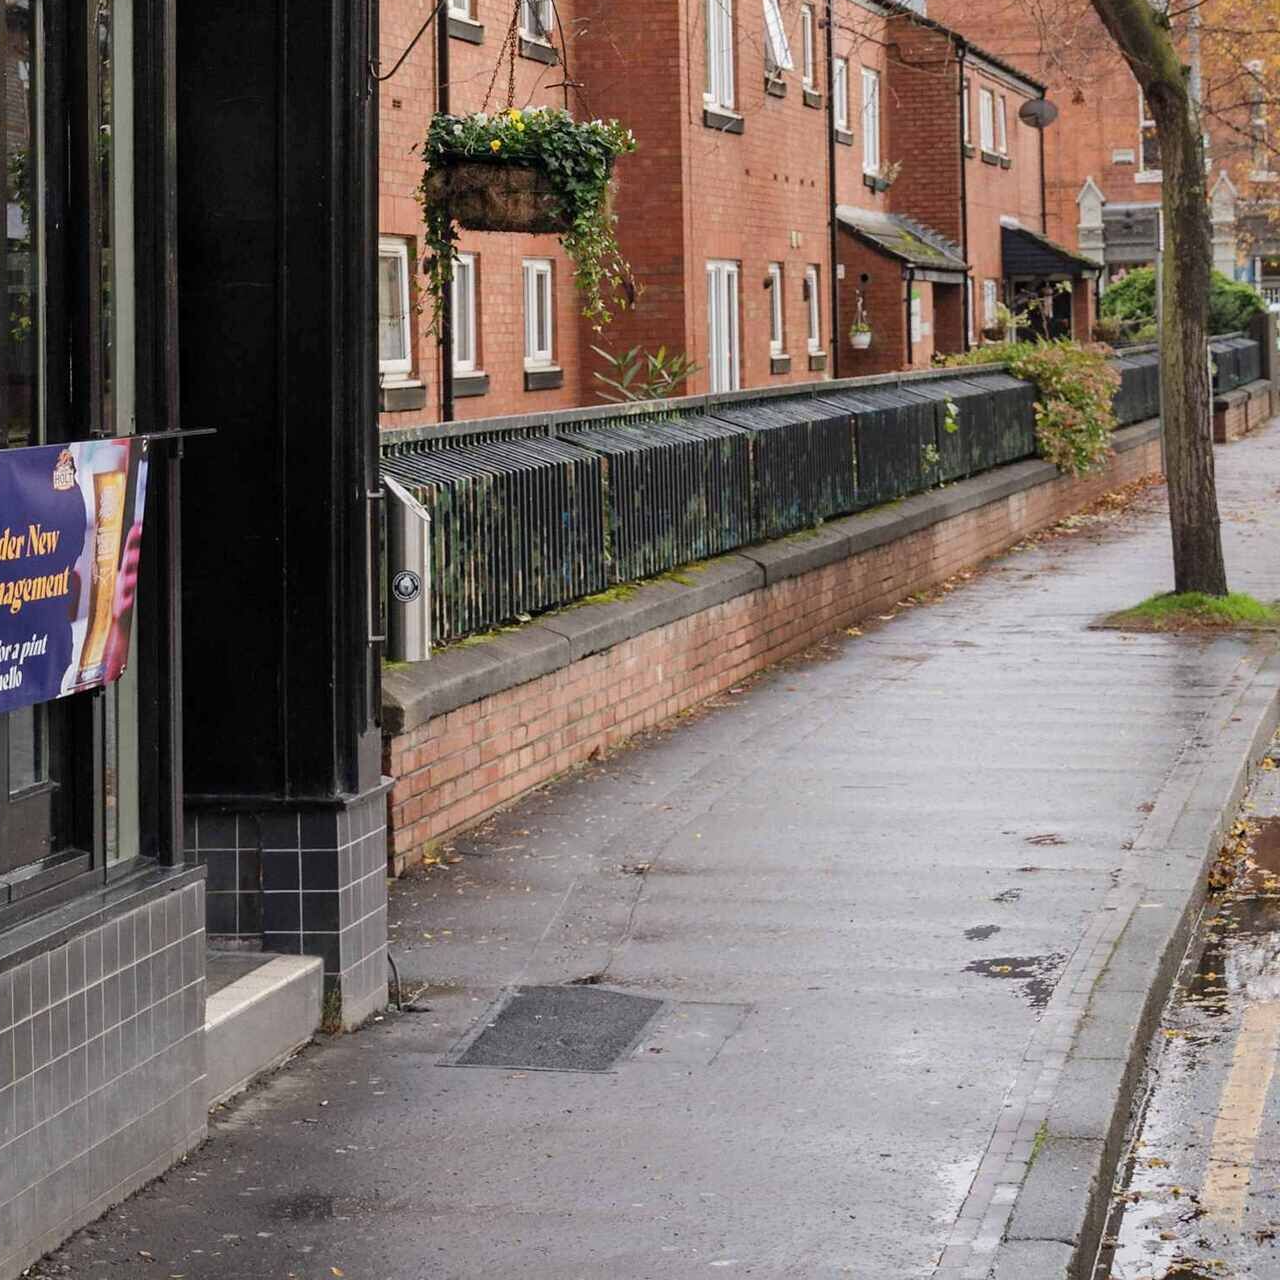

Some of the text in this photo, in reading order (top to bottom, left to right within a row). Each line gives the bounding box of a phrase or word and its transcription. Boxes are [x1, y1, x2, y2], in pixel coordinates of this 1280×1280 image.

[55, 470, 72, 485] HOLT
[26, 524, 60, 557] New
[11, 643, 20, 660] a
[19, 634, 48, 665] pint
